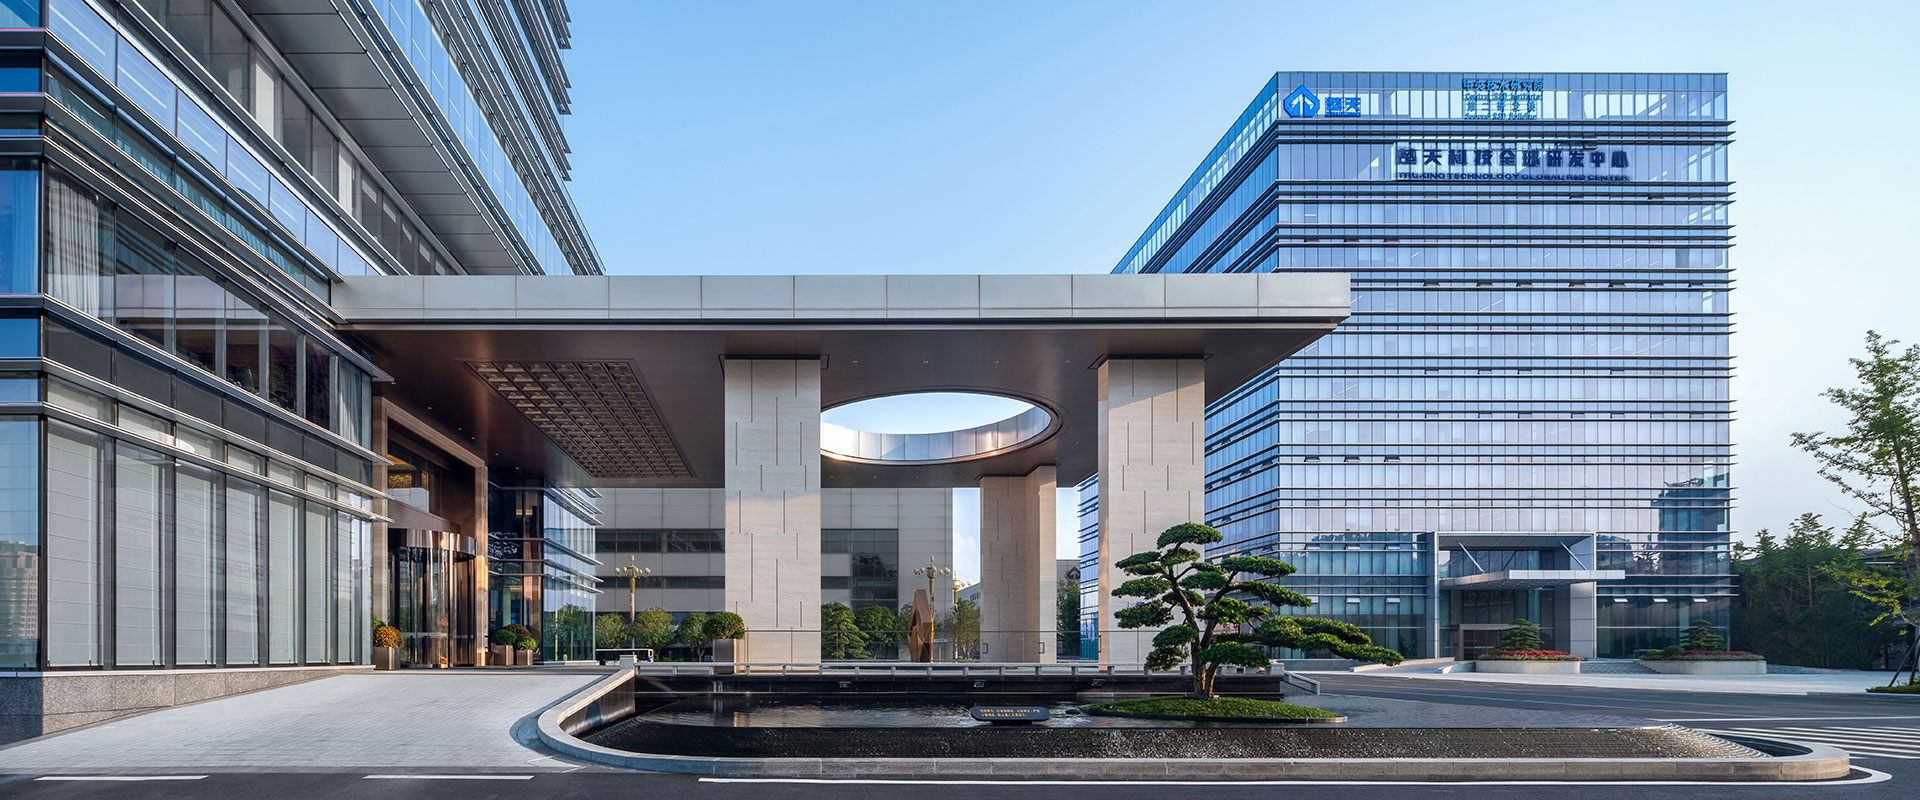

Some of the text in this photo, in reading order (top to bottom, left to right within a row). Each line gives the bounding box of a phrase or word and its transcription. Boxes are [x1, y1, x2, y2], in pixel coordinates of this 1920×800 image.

[1463, 79, 1543, 91] 中央技术研究院
[1447, 172, 1519, 180] TECHNOLOGY
[1588, 173, 1629, 181] CENTER
